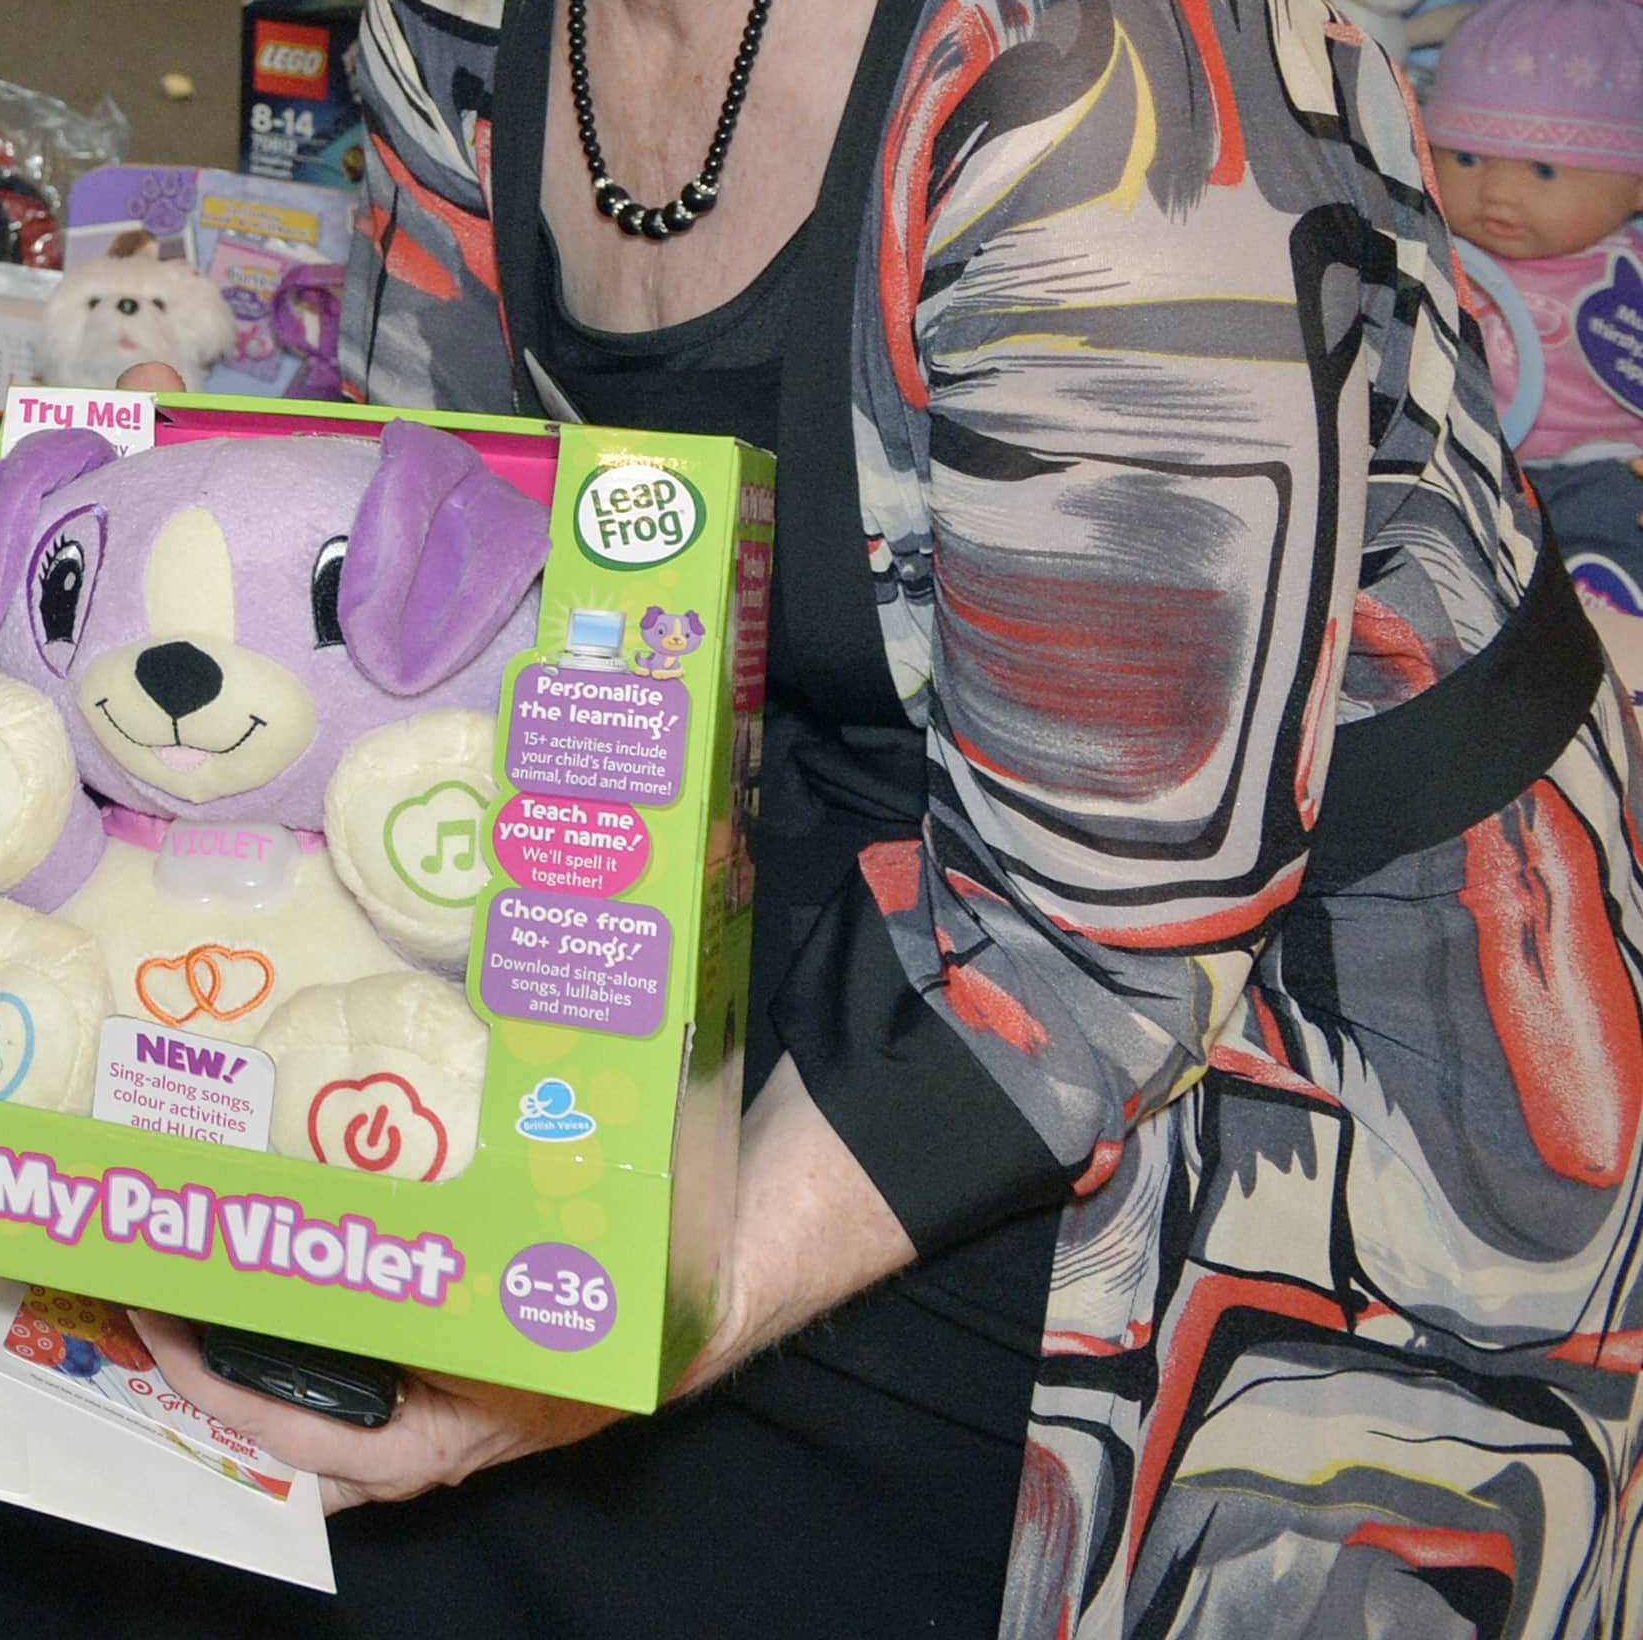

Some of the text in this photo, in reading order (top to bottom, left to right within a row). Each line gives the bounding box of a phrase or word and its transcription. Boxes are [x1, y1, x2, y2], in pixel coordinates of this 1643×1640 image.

[261, 44, 322, 75] LEGO
[251, 103, 315, 138] 8-14
[19, 397, 142, 430] Try Me!
[591, 479, 677, 518] Leap
[598, 510, 685, 549] Frog
[536, 675, 664, 707] Personalise
[518, 699, 680, 740] the learning!
[522, 730, 669, 760] 15+ activities include
[520, 750, 666, 778] your child's favourite
[511, 765, 673, 797] animal, food and more!
[520, 798, 635, 830] Teach me
[170, 829, 275, 862] VIOLET
[498, 821, 645, 853] your name!
[521, 846, 619, 873] We'll spell it
[530, 867, 605, 890] together!
[499, 898, 659, 937] Choose from
[510, 926, 644, 968] 40+ songs!
[489, 953, 658, 995] Download sing-along
[510, 976, 633, 1007] songs, lullabies
[528, 998, 611, 1023] and more!
[135, 1031, 249, 1085] NEW!
[109, 1061, 256, 1116] Sing-along songs,
[112, 1087, 248, 1134] colour activities
[130, 1113, 163, 1133] and
[107, 1170, 212, 1258] Pal
[220, 1198, 462, 1303] Violet
[505, 1262, 610, 1312] 6-36
[518, 1304, 597, 1333] months
[156, 1392, 202, 1420] Gift
